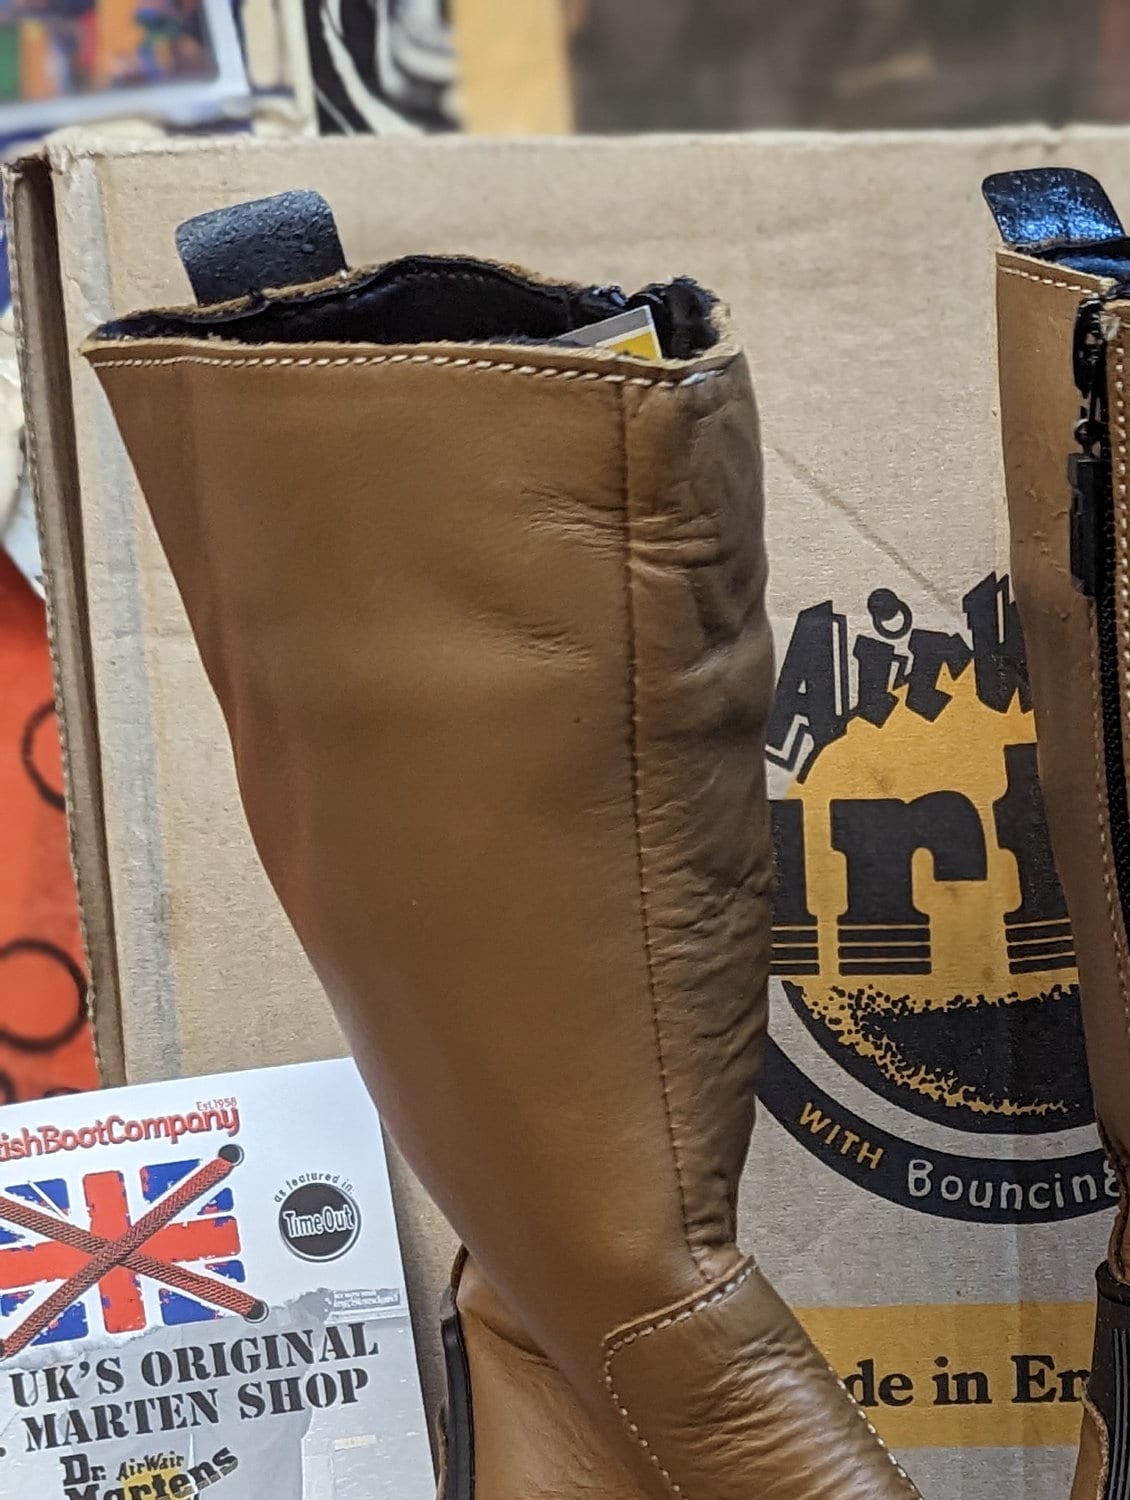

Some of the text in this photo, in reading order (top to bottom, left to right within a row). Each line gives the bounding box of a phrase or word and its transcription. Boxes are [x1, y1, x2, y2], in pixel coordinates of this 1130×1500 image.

[765, 567, 1037, 785] AirW
[797, 1100, 887, 1172] WITH
[286, 1171, 340, 1190] featured
[283, 1204, 355, 1238] Time Out
[8, 1322, 380, 1408] UK'S ORIGINAL
[842, 1358, 914, 1408] de
[932, 1355, 993, 1406] in
[21, 1367, 369, 1452] MARTEN SHOP
[116, 1450, 185, 1482] AirWair
